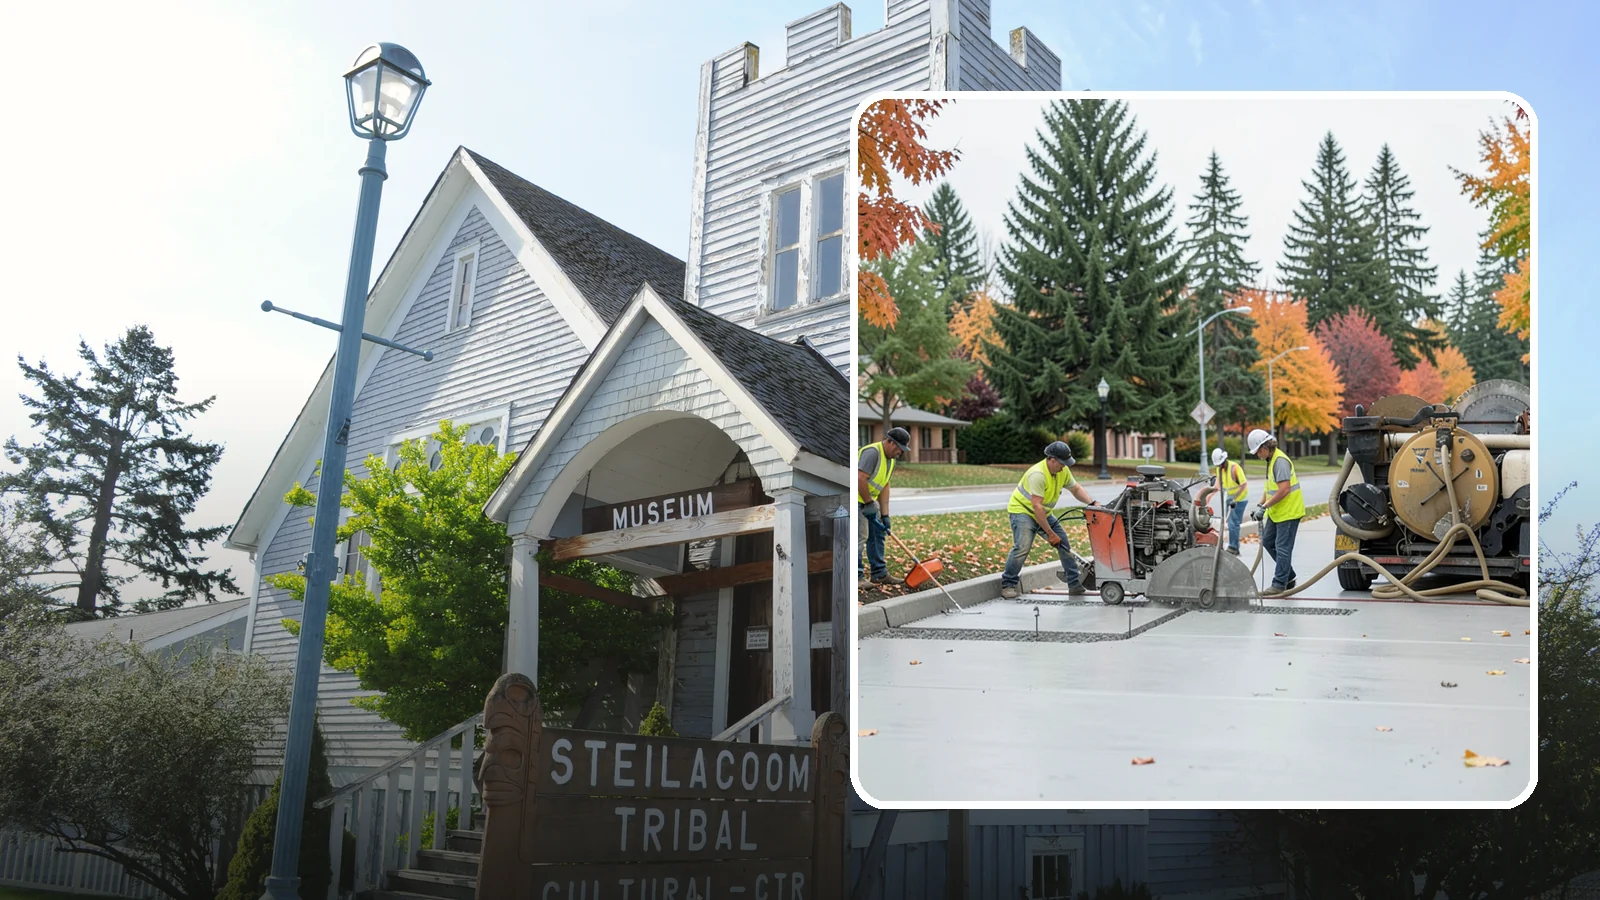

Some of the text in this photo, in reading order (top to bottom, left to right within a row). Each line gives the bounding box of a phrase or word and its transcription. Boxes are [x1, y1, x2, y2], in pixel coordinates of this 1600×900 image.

[612, 491, 714, 531] MUSEUM
[550, 738, 810, 792] STEILACOOM
[614, 806, 758, 851] TRIBAL
